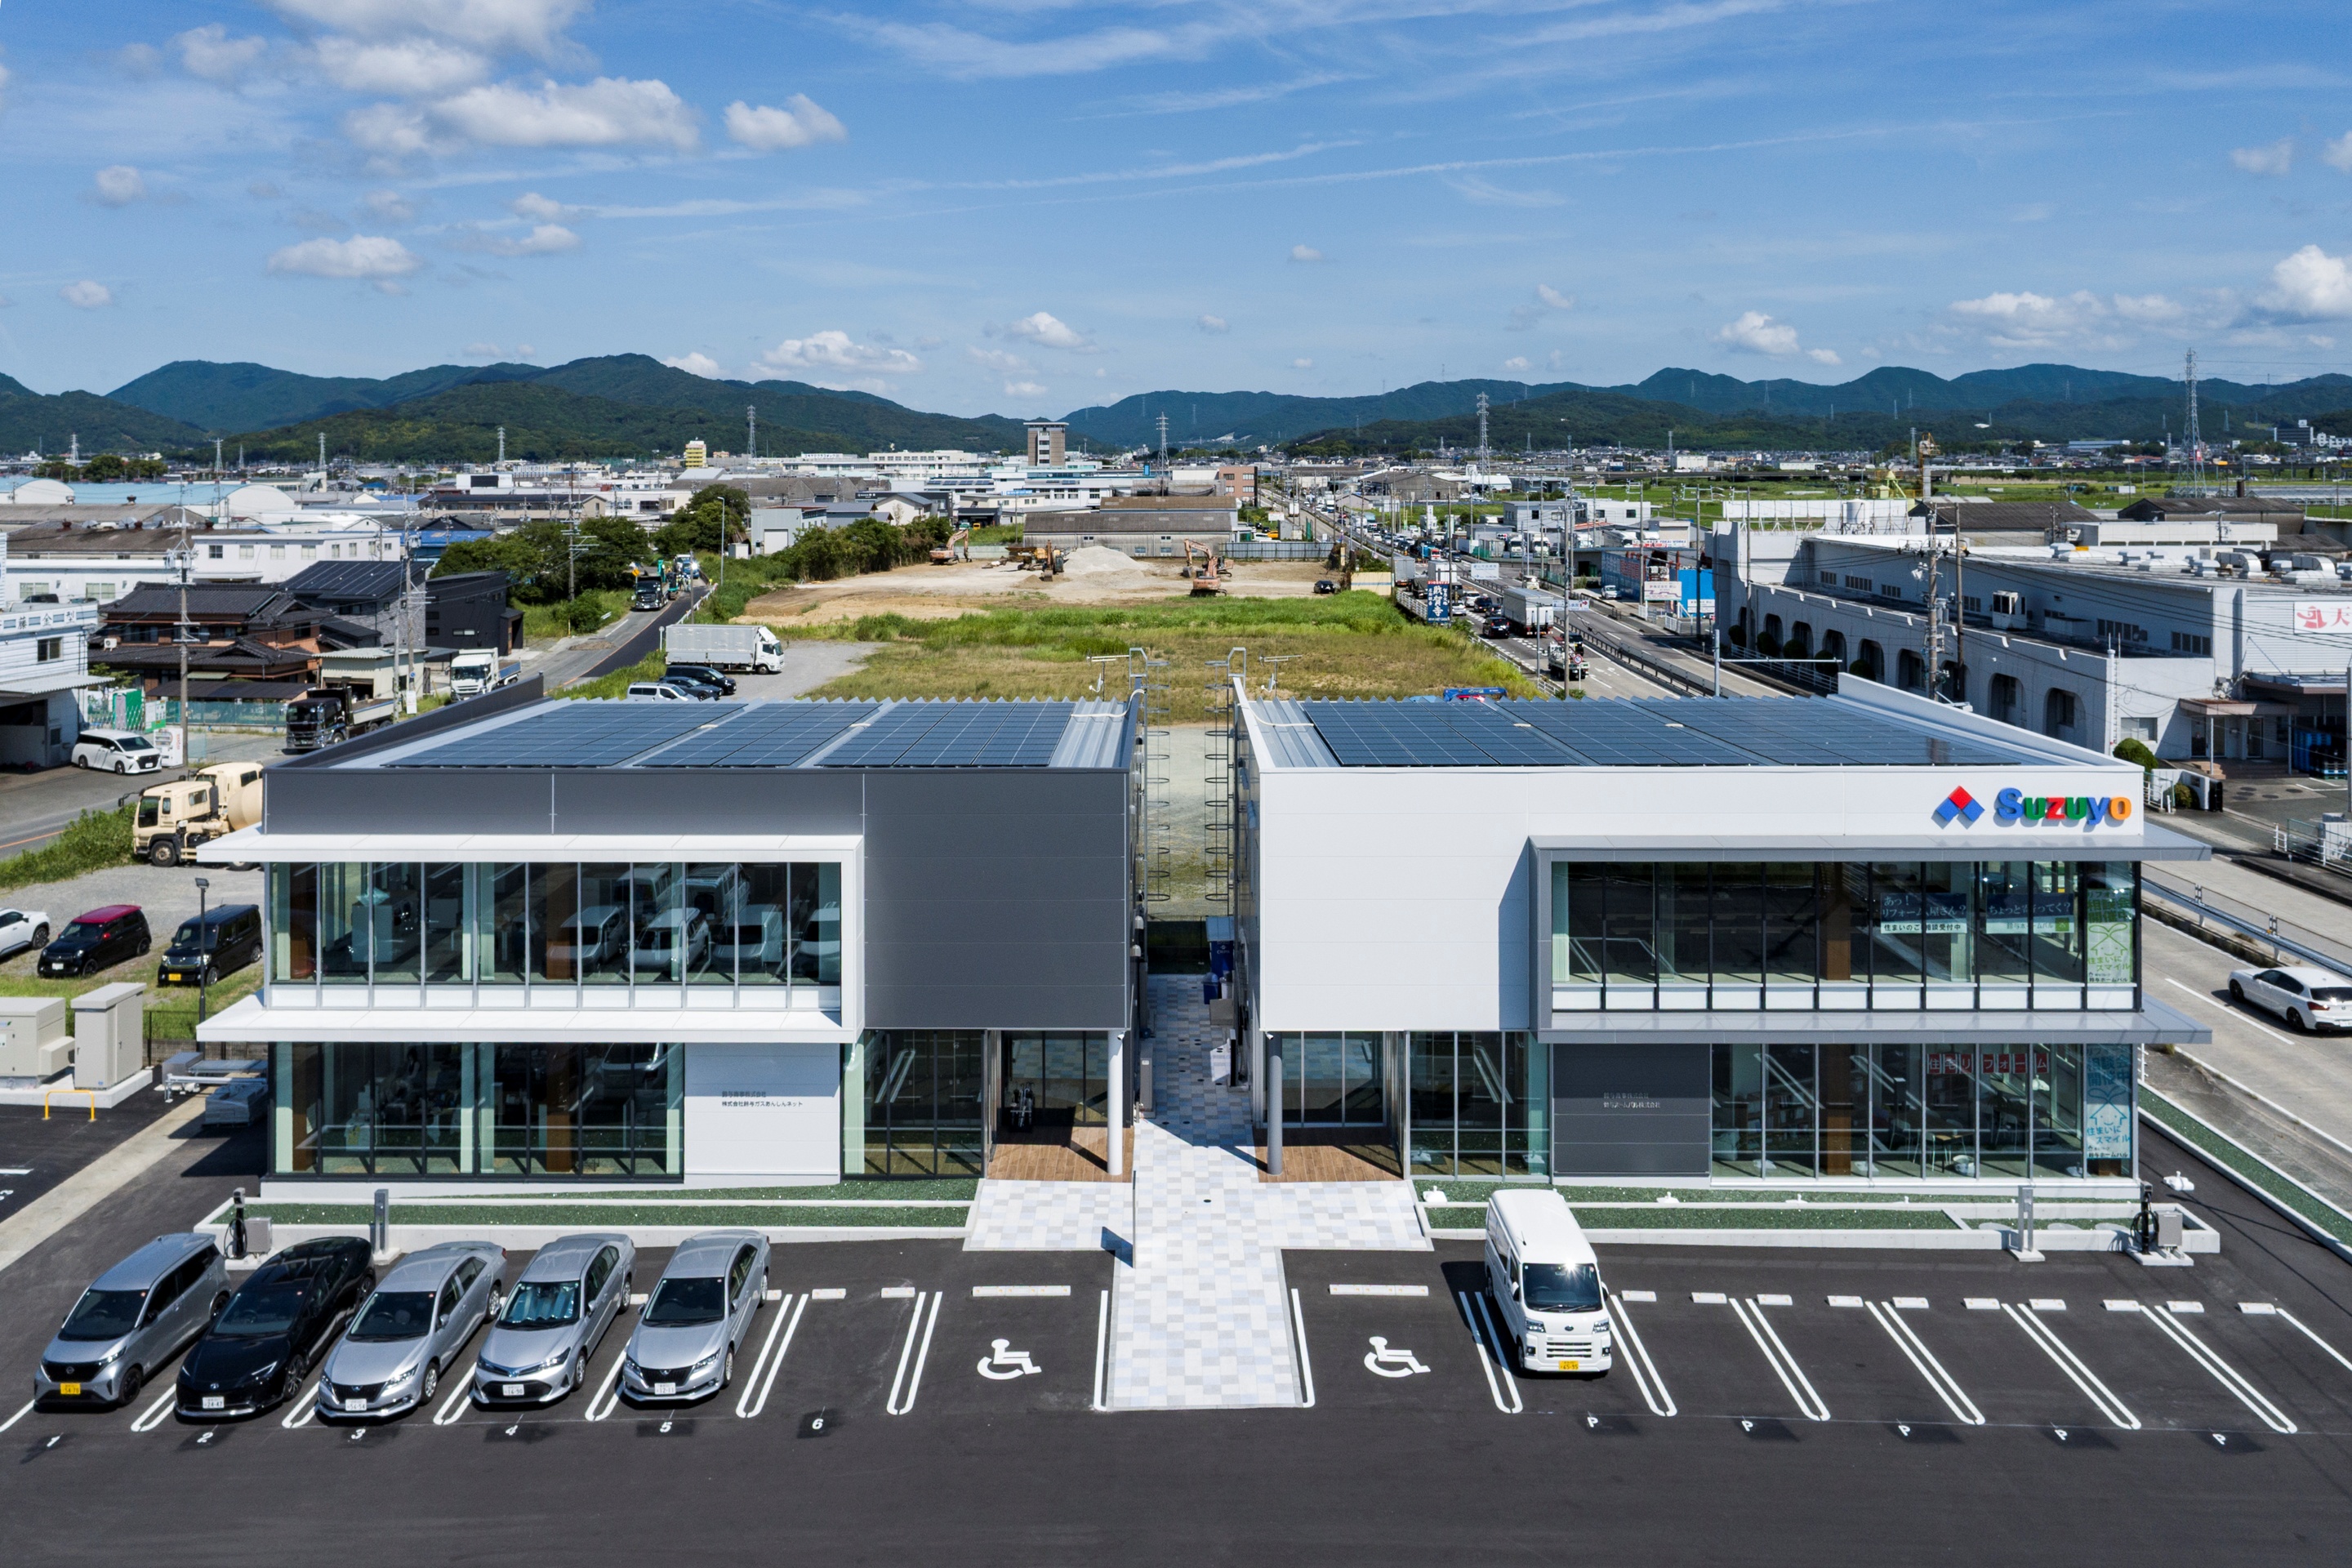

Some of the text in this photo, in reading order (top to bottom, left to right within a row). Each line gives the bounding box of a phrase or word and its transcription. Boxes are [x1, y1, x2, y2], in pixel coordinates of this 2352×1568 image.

[1997, 787, 2132, 826] Suzuyo
[2088, 956, 2122, 964] 住まいに
[2096, 964, 2131, 972] スマイル
[1929, 1058, 2047, 1070] 住宅リフォーム
[2087, 1125, 2122, 1136] 住まいに
[2096, 1135, 2130, 1144] スマイル
[659, 1421, 673, 1432] 5
[812, 1418, 823, 1430] 6
[351, 1428, 366, 1439] 3
[505, 1424, 519, 1436] 4
[46, 1436, 60, 1447] 1
[197, 1432, 214, 1443] 2
